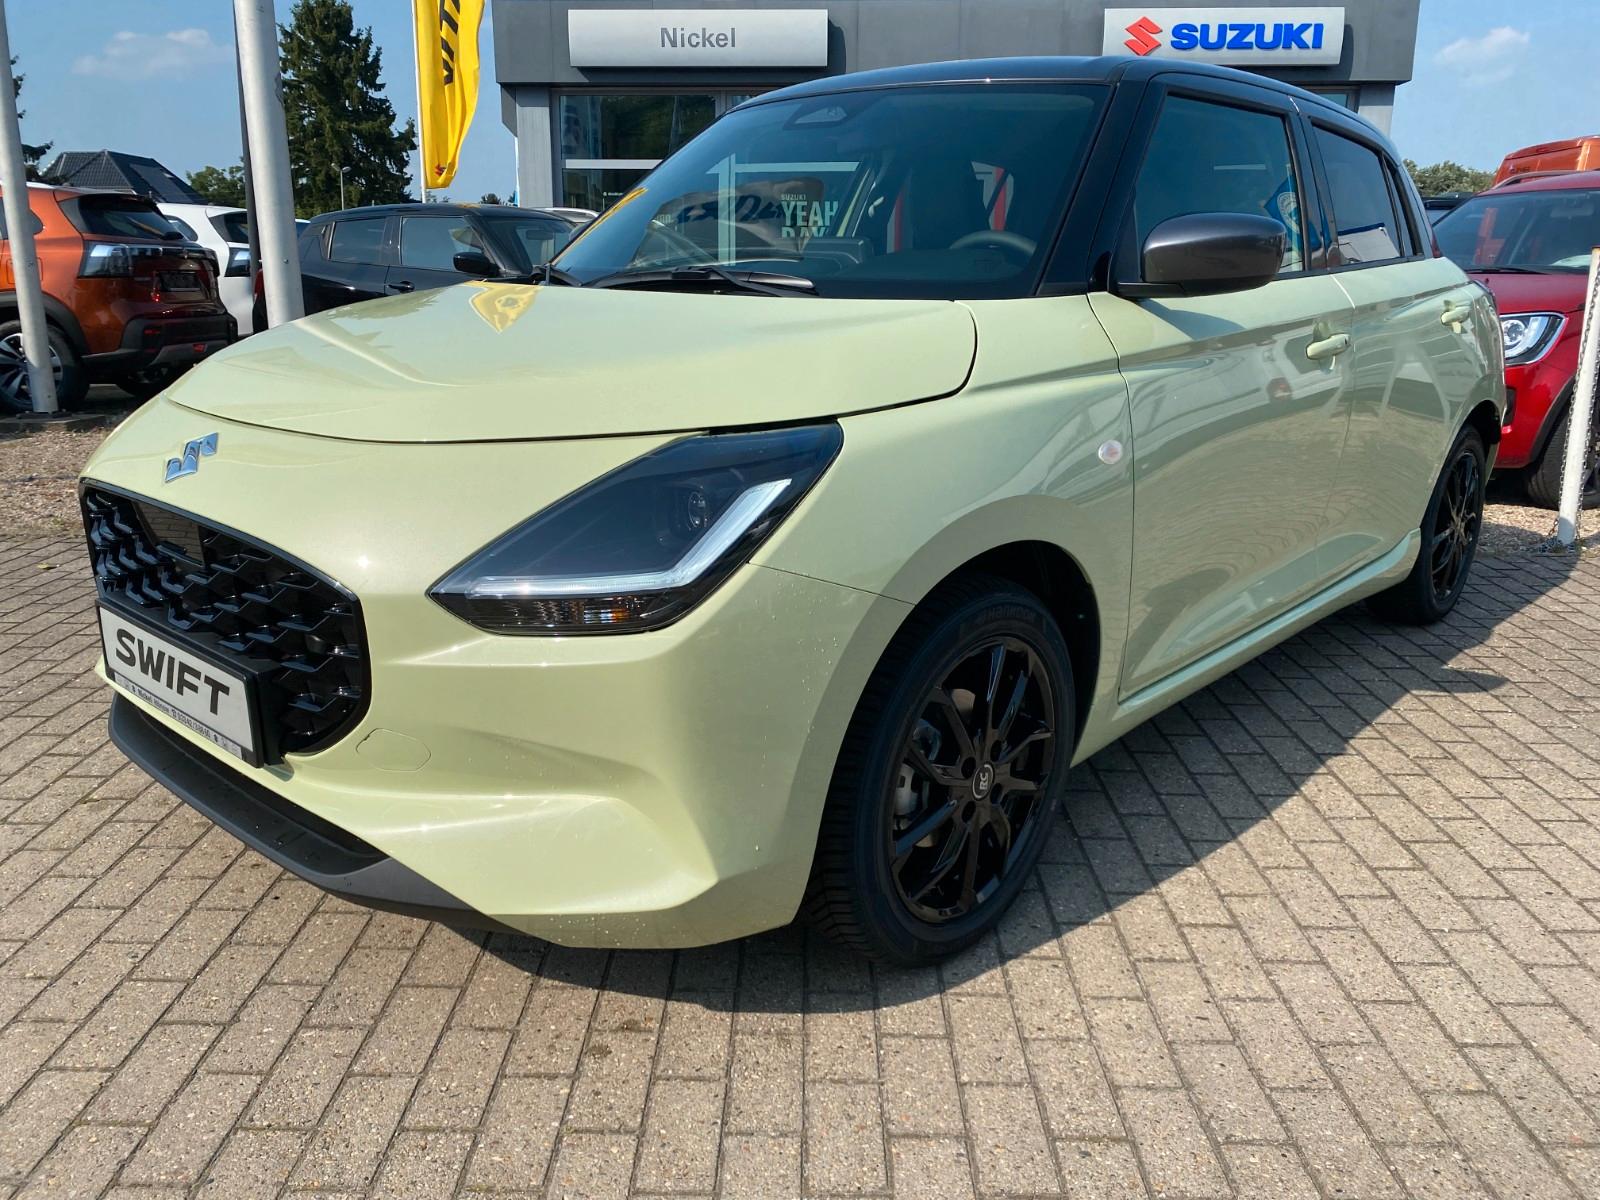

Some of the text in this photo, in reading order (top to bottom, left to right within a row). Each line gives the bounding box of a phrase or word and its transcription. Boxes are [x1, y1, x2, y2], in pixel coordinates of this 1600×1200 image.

[660, 27, 736, 48] Nickel
[1170, 23, 1324, 50] SUZUKI
[780, 200, 839, 227] YEAH
[115, 628, 230, 716] SWIFT
